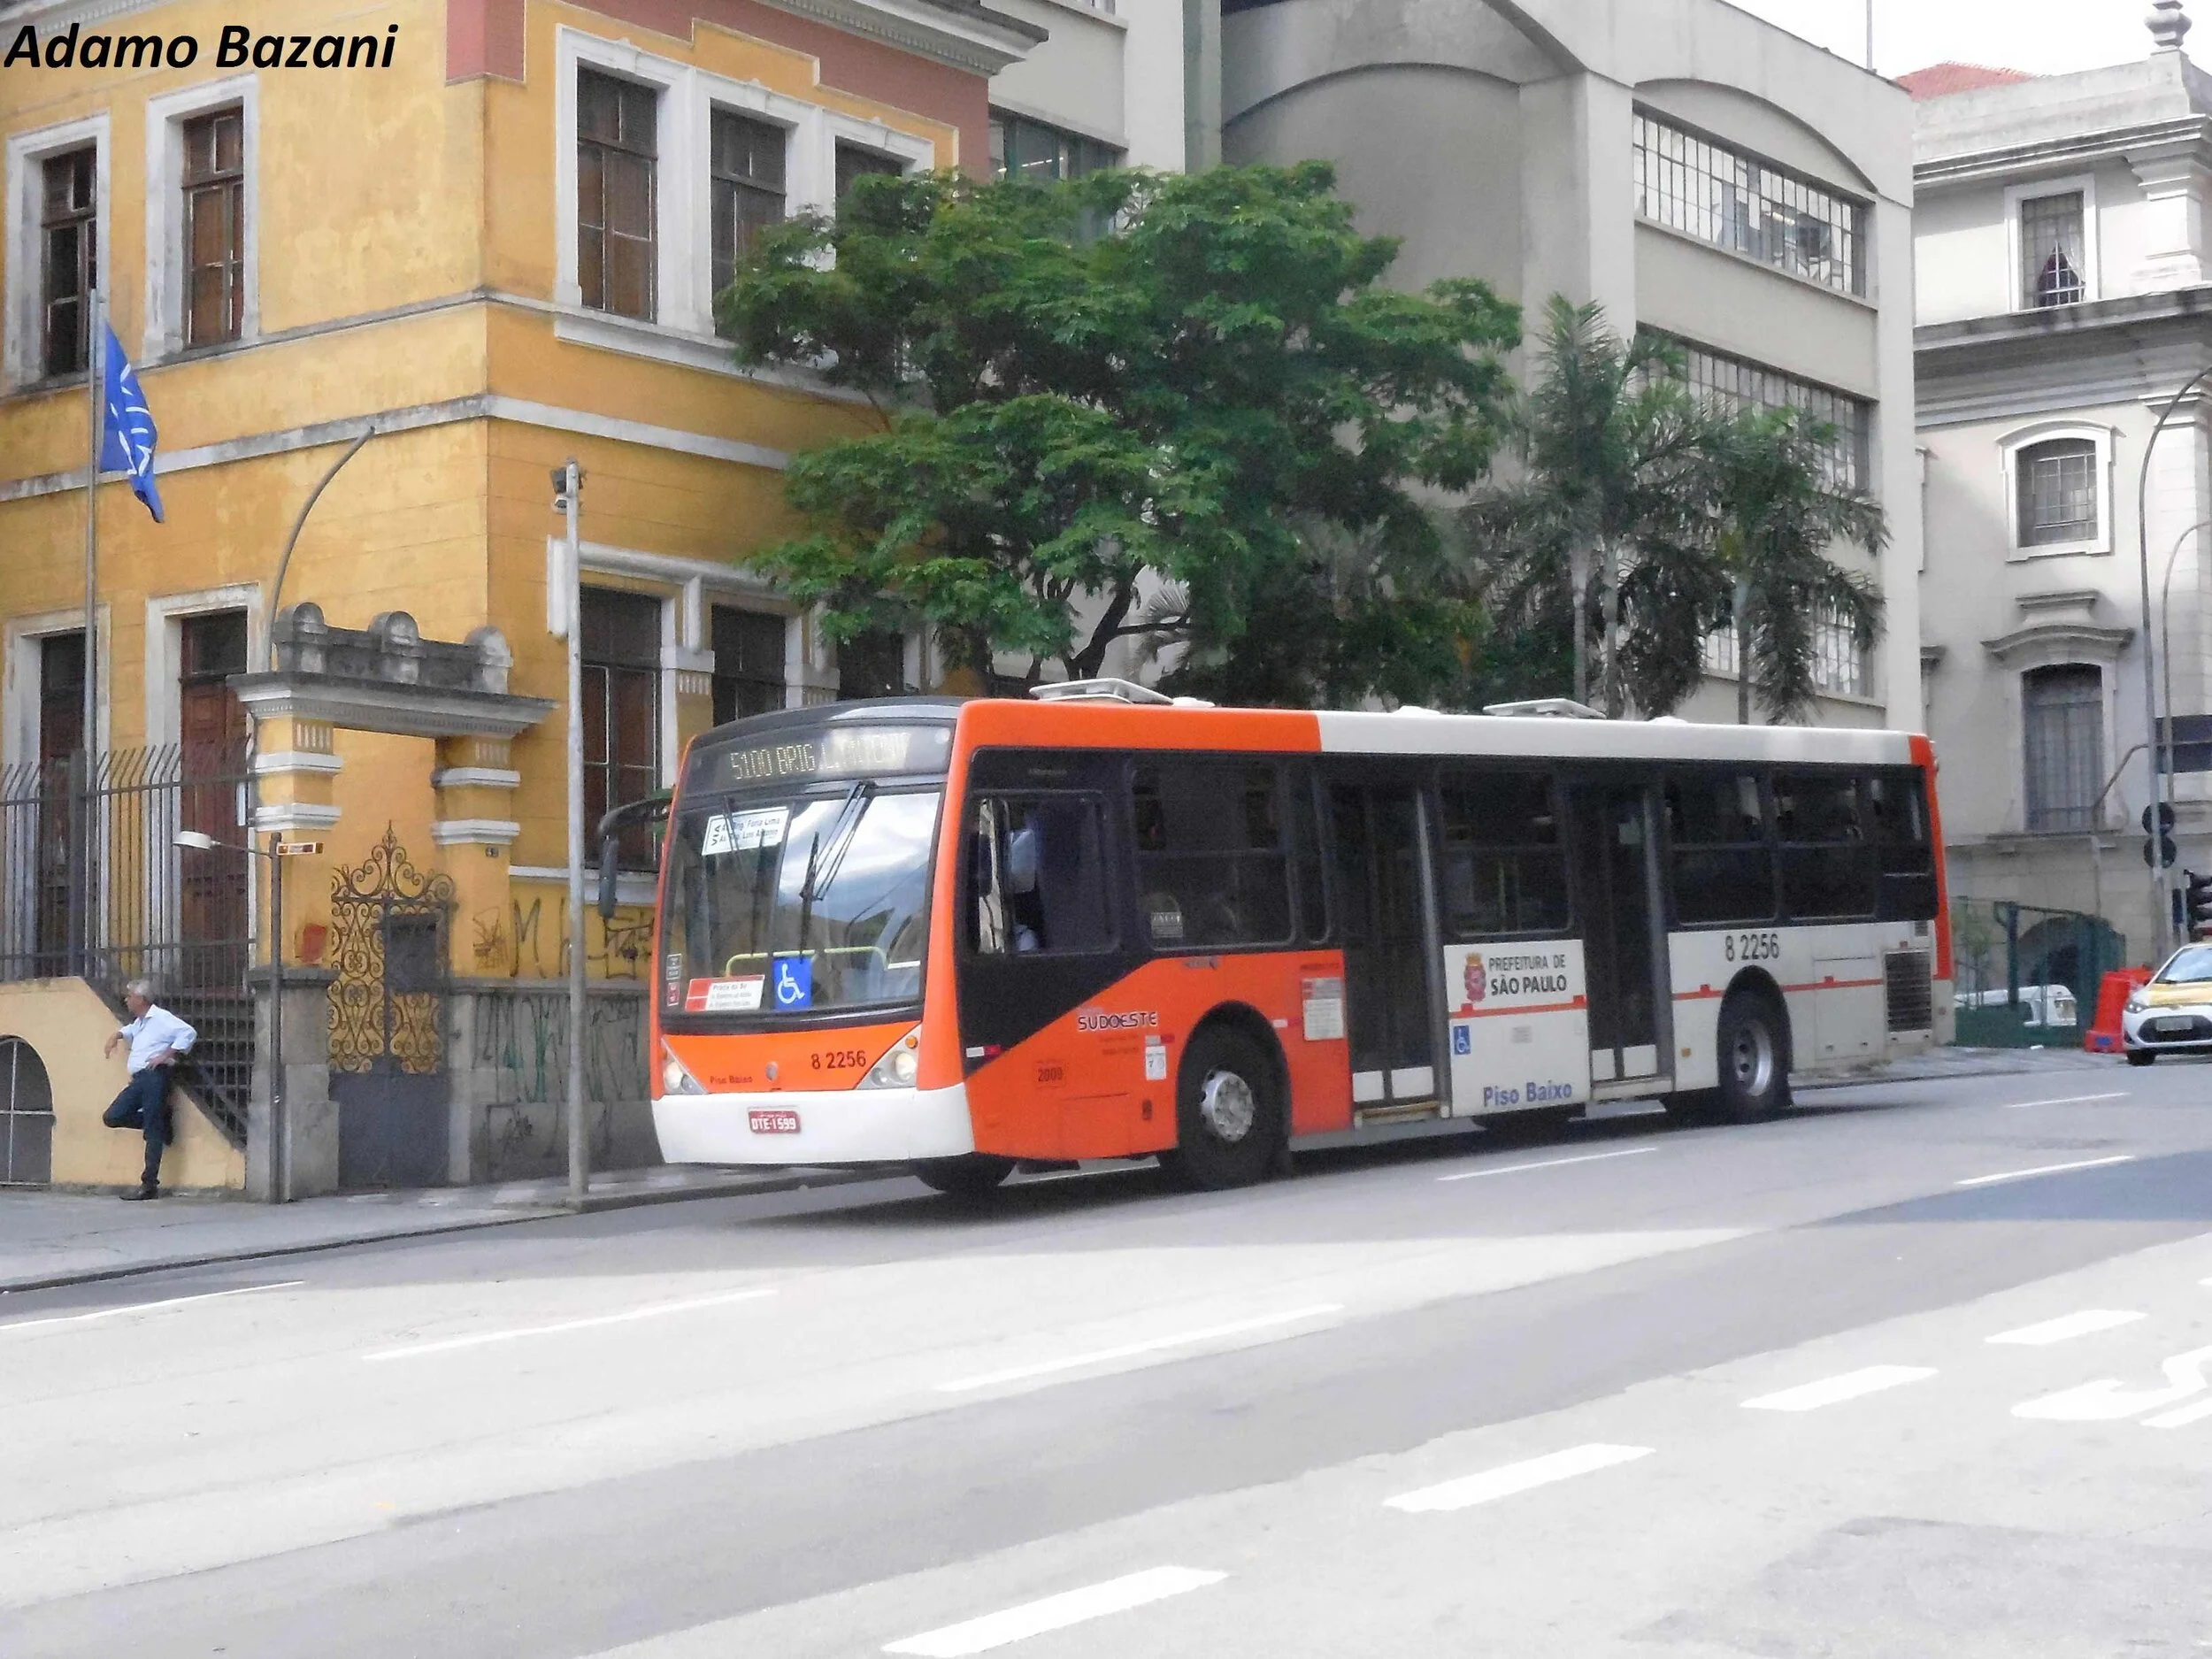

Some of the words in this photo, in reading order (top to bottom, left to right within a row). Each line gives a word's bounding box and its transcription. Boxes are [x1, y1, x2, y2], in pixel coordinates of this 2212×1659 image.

[730, 749, 772, 780] 5100
[1725, 935, 1735, 962] 8
[1740, 933, 1780, 960] 2256
[1488, 955, 1549, 972] PREFEITURA
[1553, 954, 1566, 969] DE
[1490, 974, 1520, 996] SÃO
[1522, 974, 1567, 994] PAULO
[1078, 1011, 1157, 1031] SUDOESTE
[810, 1053, 821, 1070] 8
[826, 1050, 866, 1069] 2256
[1483, 1086, 1519, 1107] Piso
[1525, 1080, 1572, 1103] Baixo
